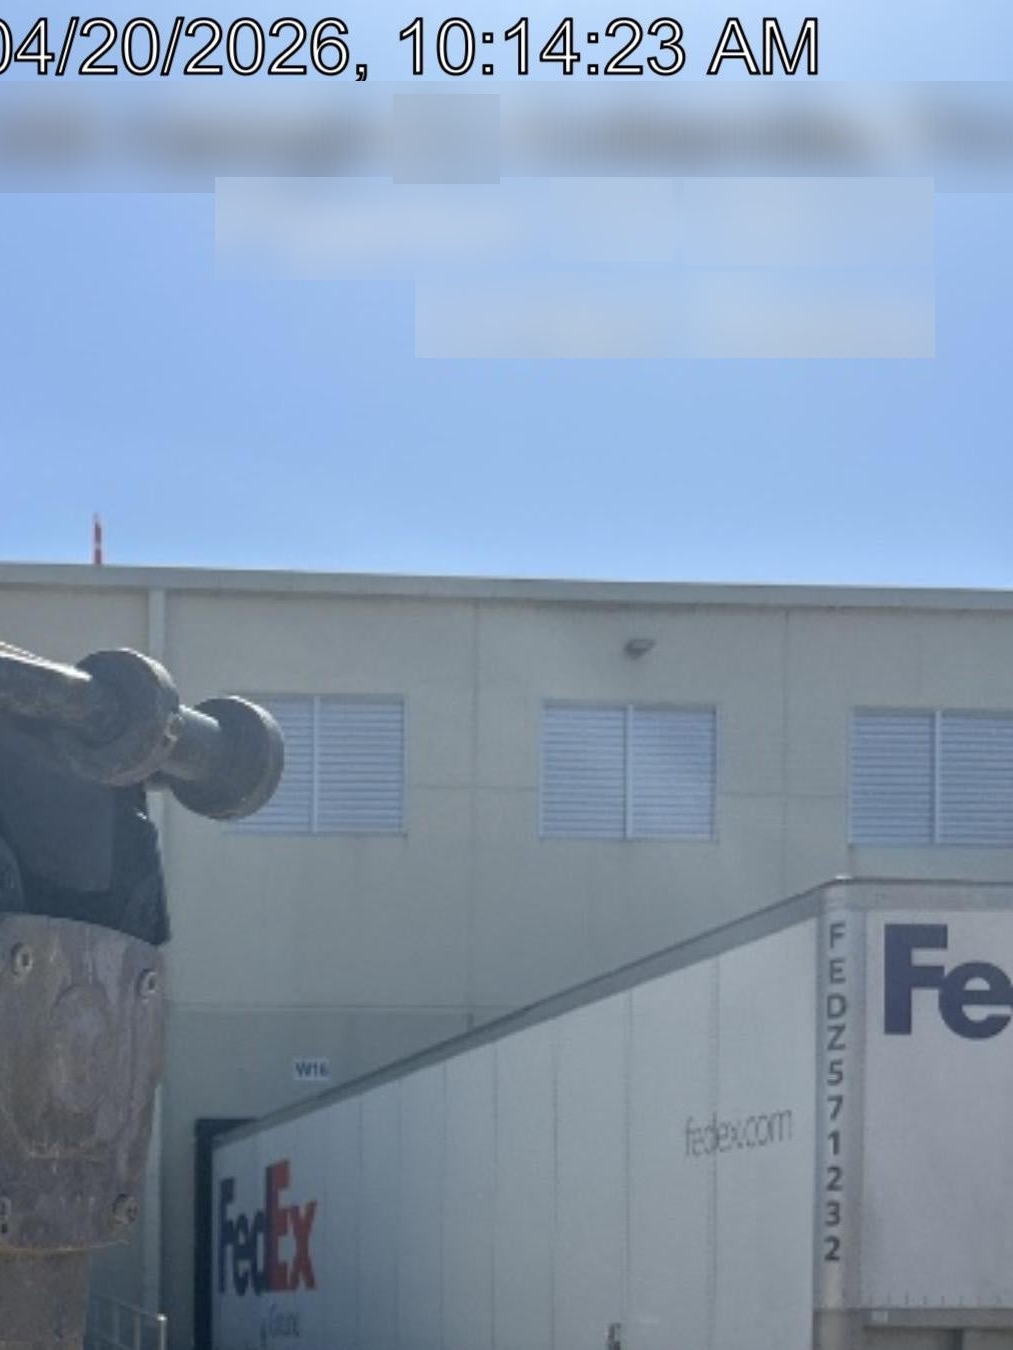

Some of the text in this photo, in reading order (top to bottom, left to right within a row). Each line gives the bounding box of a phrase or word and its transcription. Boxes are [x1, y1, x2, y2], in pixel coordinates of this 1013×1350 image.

[883, 922, 1013, 1040] Fe
[684, 1108, 794, 1157] fedex.com
[823, 921, 848, 1262] FEDZ571232
[219, 1158, 318, 1297] FedEx
